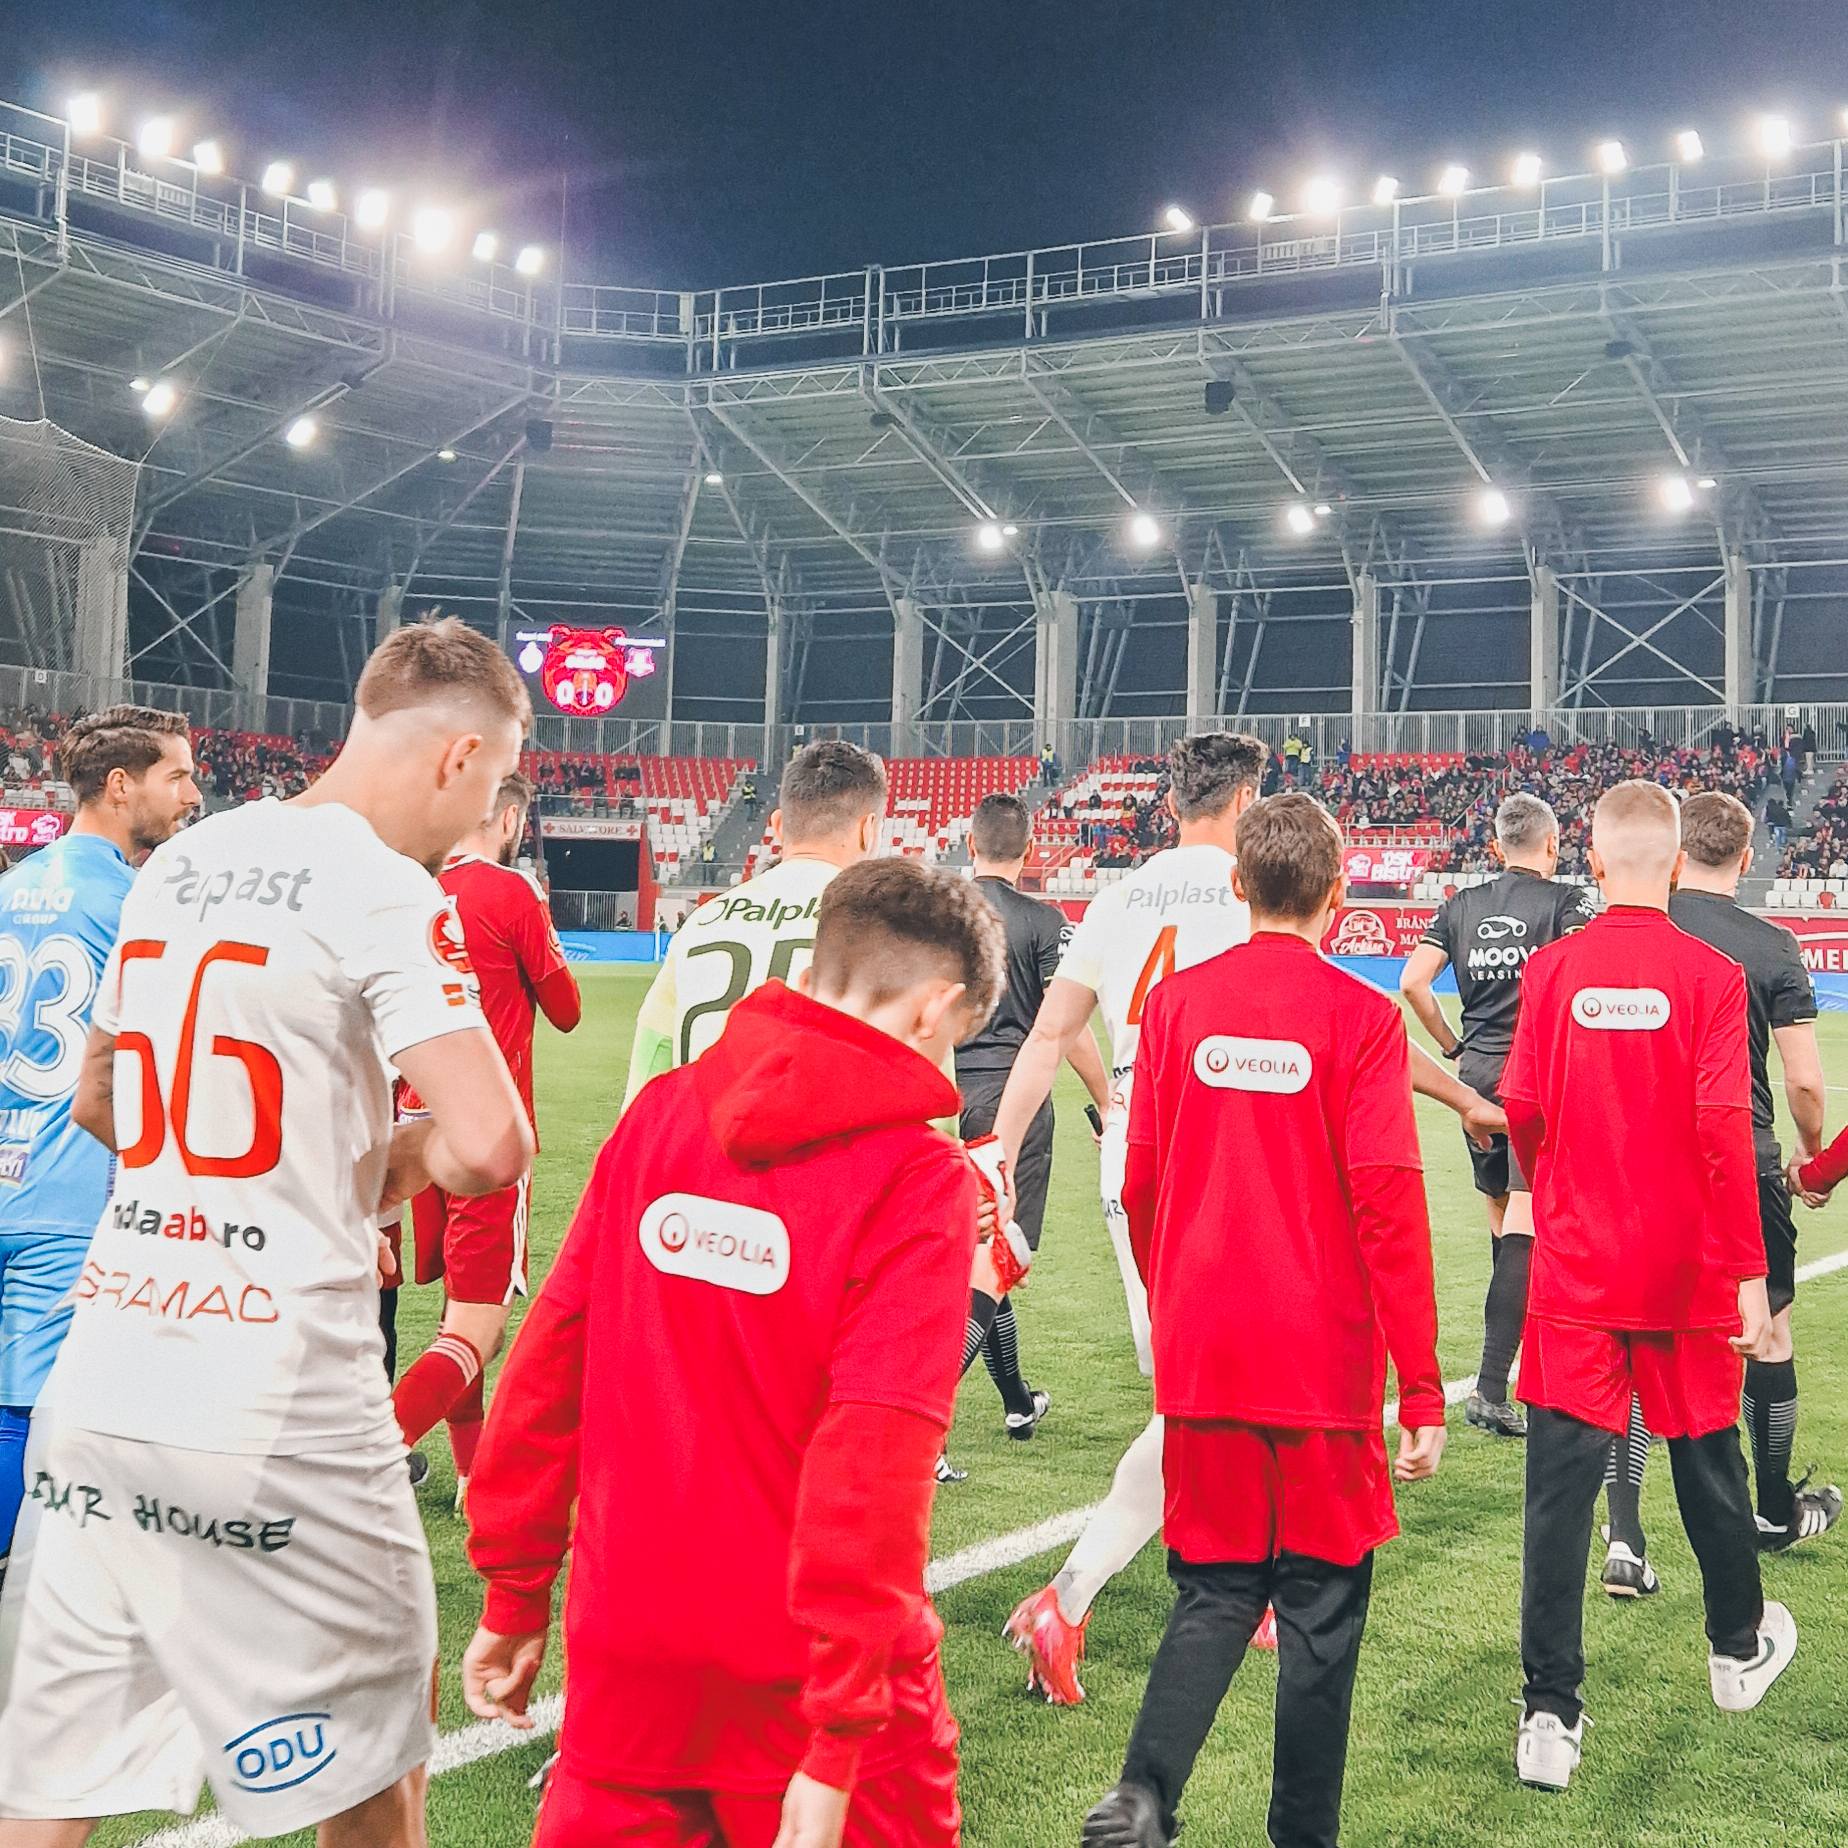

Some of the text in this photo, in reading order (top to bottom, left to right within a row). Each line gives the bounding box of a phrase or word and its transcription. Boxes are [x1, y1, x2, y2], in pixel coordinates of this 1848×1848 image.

[1470, 970, 1523, 981] LEASIN
[1235, 1057, 1300, 1077] VEOLIA
[692, 1228, 777, 1270] VEOLIA
[133, 1494, 296, 1552] HOUSE
[237, 1723, 325, 1779] ODU
